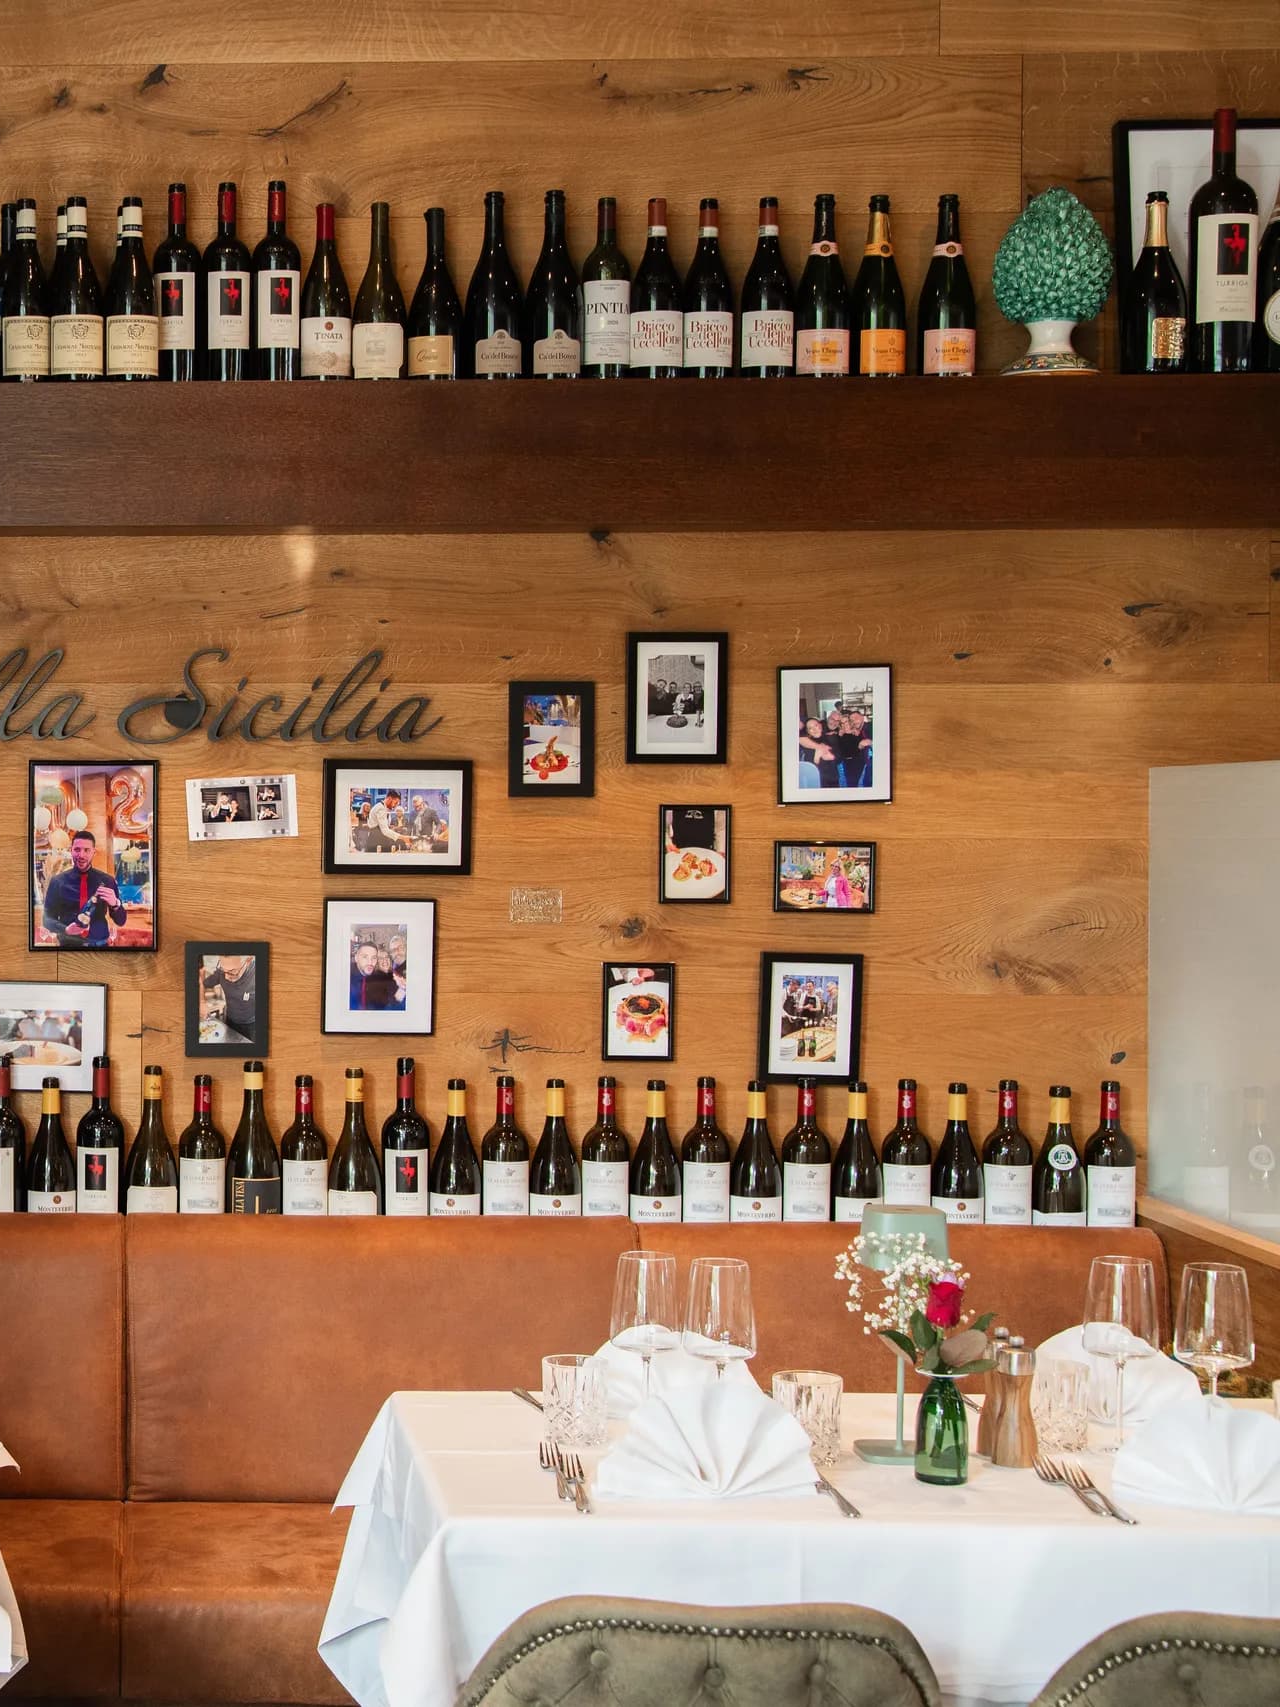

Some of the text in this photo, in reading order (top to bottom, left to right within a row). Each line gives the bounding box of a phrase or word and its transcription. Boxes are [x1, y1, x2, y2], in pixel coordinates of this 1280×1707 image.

[586, 302, 630, 315] PINTIA
[637, 320, 675, 333] Bricco
[690, 320, 728, 333] Bricco
[754, 319, 791, 332] Bricco
[117, 648, 445, 745] Sicilia
[638, 1209, 676, 1217] MONTEVERRO
[737, 1210, 776, 1218] MONTEVERRO
